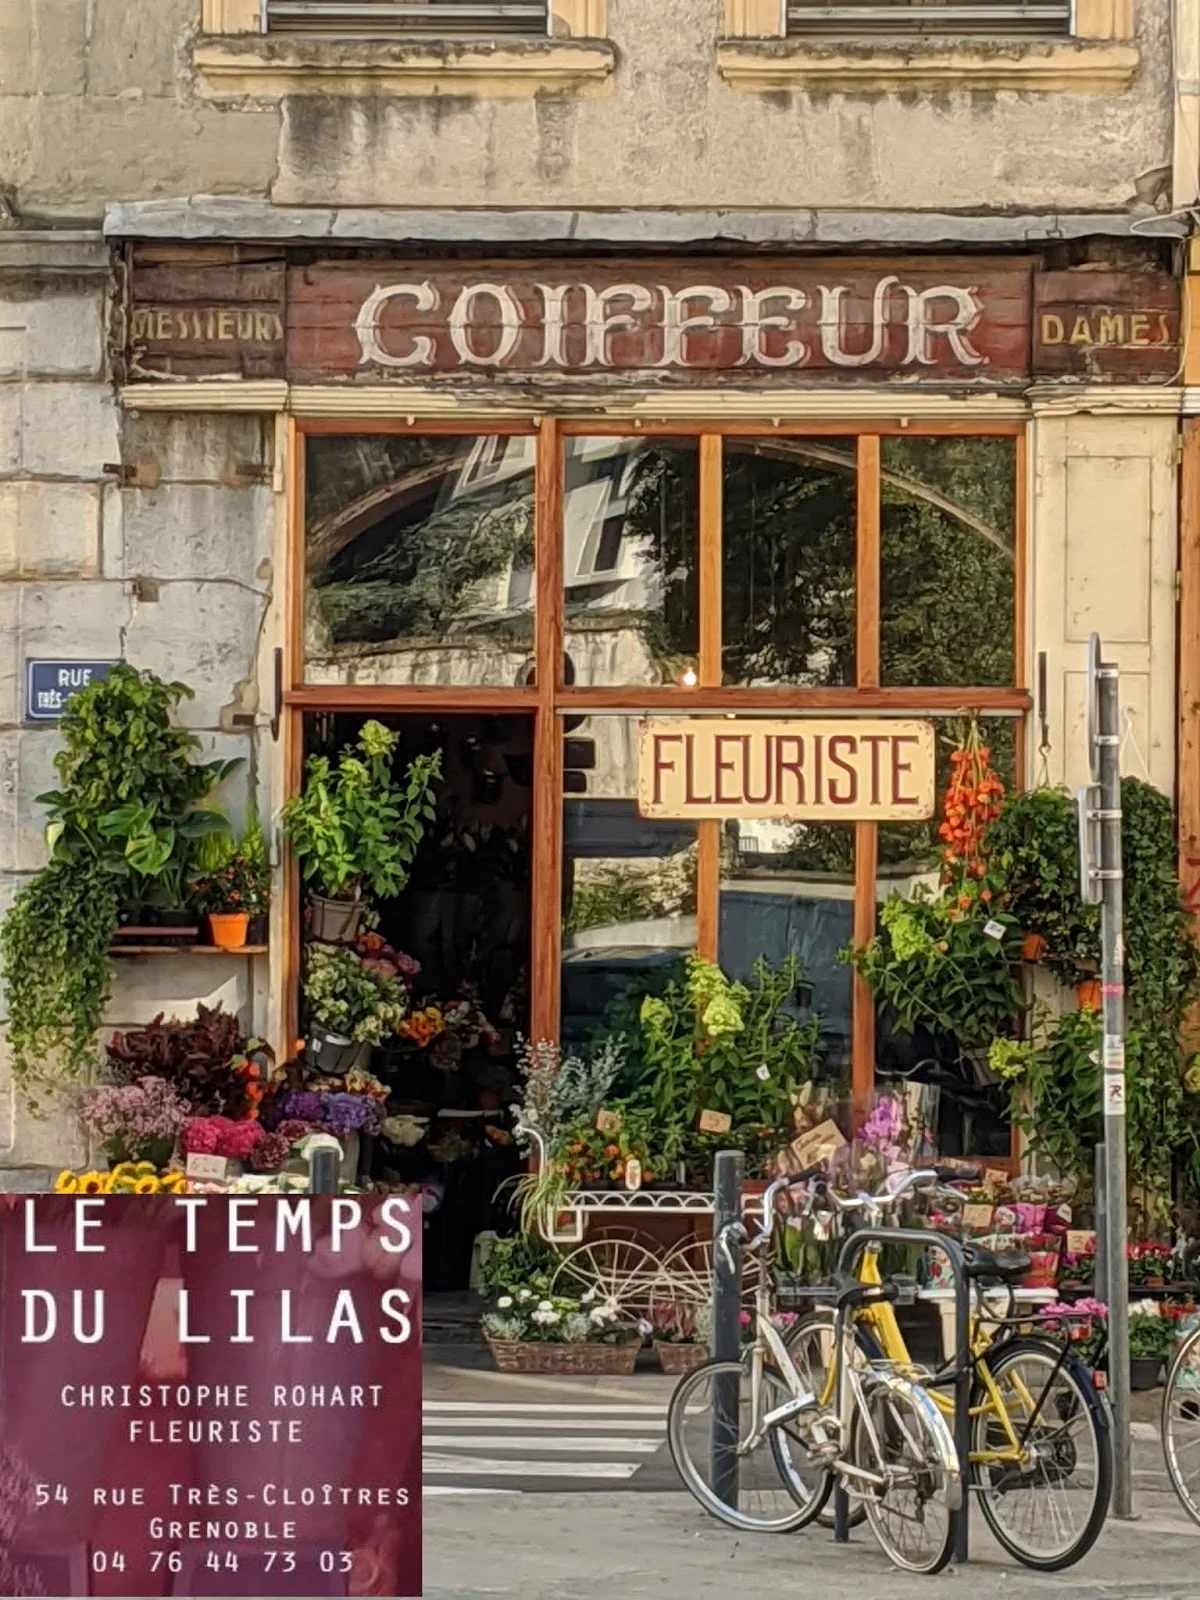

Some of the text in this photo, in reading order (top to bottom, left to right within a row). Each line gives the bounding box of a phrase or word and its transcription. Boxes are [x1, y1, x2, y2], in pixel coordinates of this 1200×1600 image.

[351, 274, 991, 368] COIFFEUR
[1040, 313, 1170, 346] DAMES
[57, 667, 93, 687] RUE
[652, 734, 920, 806] FLEURISTE
